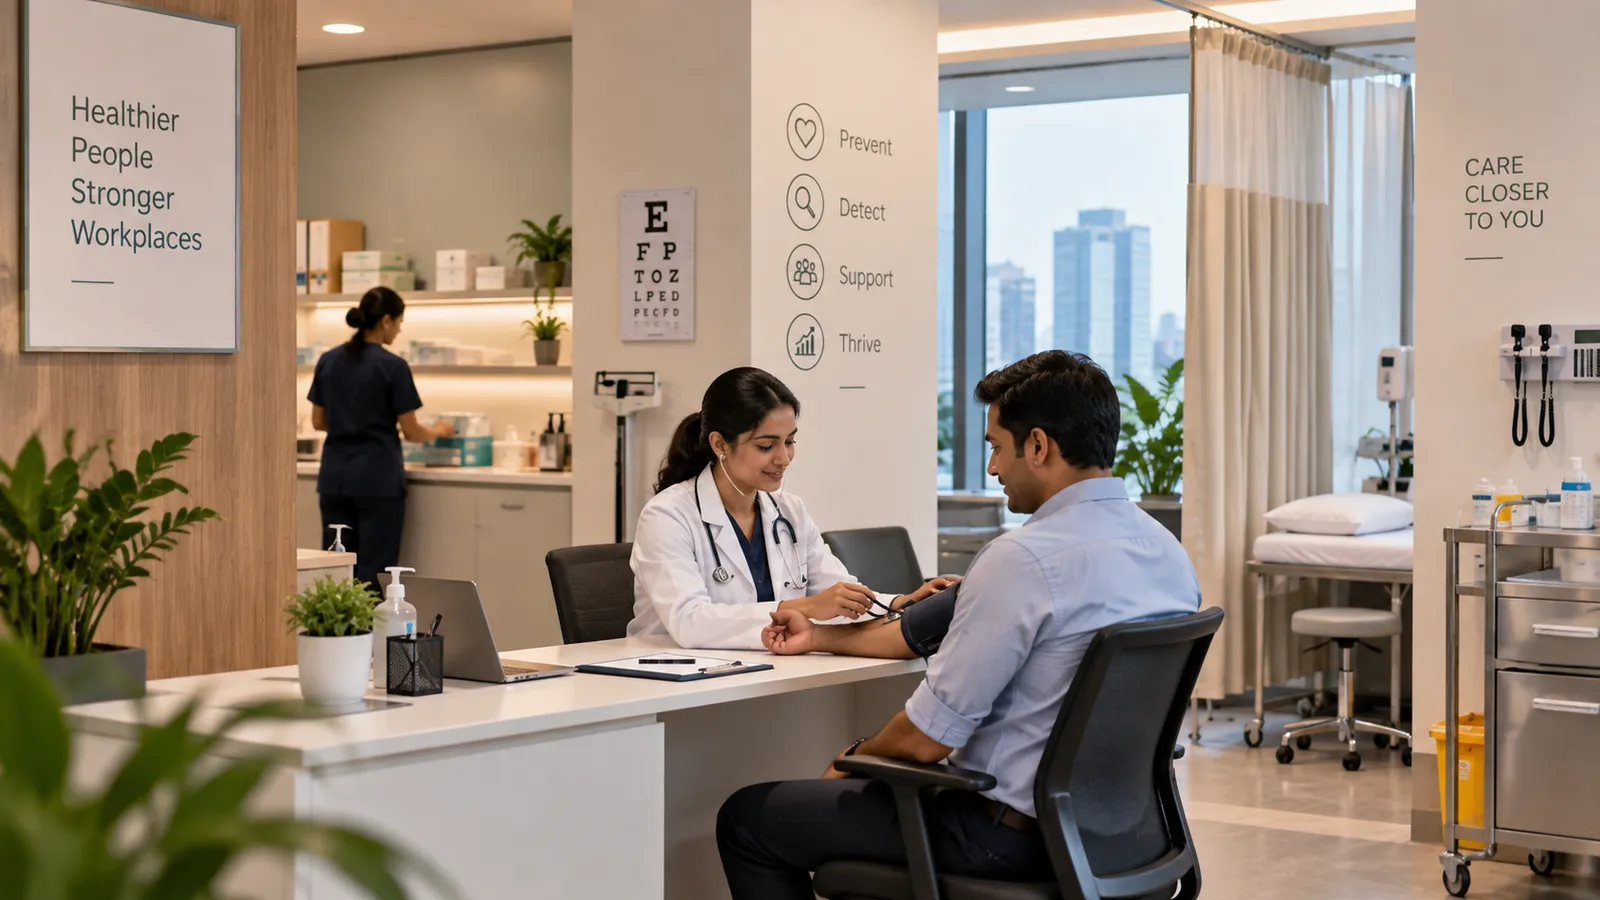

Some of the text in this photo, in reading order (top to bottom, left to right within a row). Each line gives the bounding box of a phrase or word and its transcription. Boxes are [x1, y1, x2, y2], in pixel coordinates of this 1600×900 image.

[72, 96, 180, 132] Healthier
[72, 137, 154, 173] People
[840, 129, 893, 156] Prevent
[1465, 156, 1524, 176] CARE
[72, 178, 174, 215] Stronger
[1465, 182, 1549, 203] CLOSER
[644, 200, 668, 233] E
[840, 198, 886, 221] Detect
[1465, 210, 1544, 229] TO YOU
[71, 219, 203, 254] Workplaces
[840, 266, 894, 291] Support
[839, 334, 882, 353] Thrive
